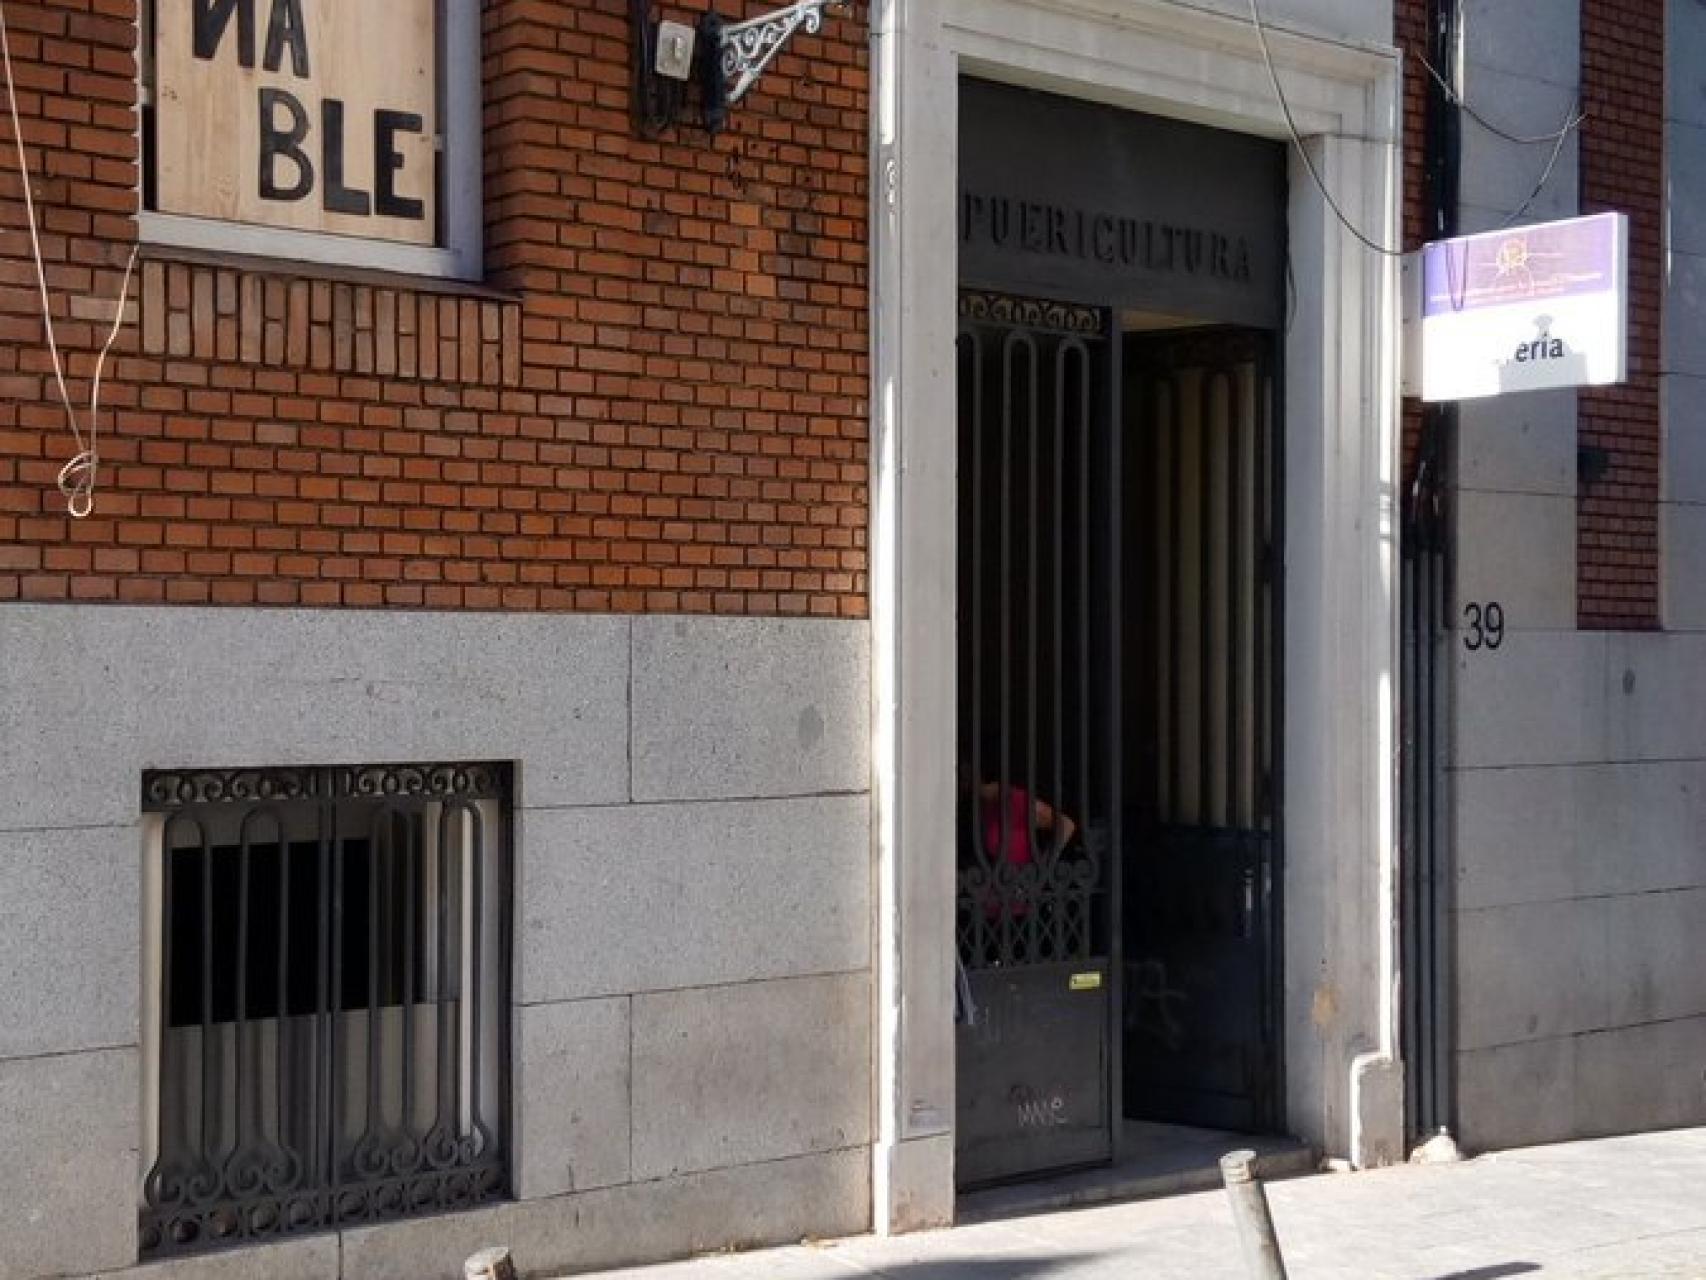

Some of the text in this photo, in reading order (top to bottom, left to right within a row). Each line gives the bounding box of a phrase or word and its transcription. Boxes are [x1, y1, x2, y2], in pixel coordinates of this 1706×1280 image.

[257, 86, 425, 221] BLE
[961, 192, 1252, 285] PUERICULTURA
[1463, 602, 1505, 651] 39
